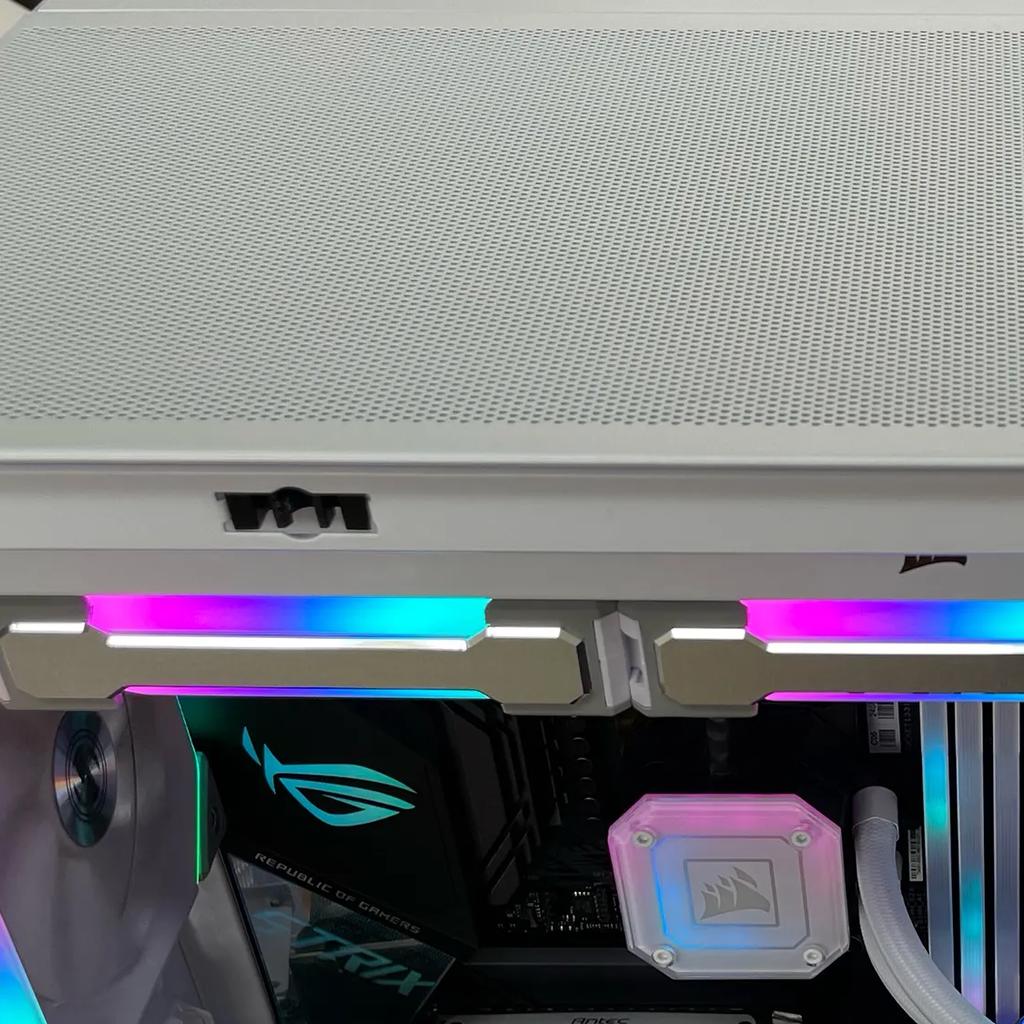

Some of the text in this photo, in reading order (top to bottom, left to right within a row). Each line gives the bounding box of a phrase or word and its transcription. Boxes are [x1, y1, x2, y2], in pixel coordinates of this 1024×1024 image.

[254, 852, 421, 935] REPUBLIC OF GAMERS
